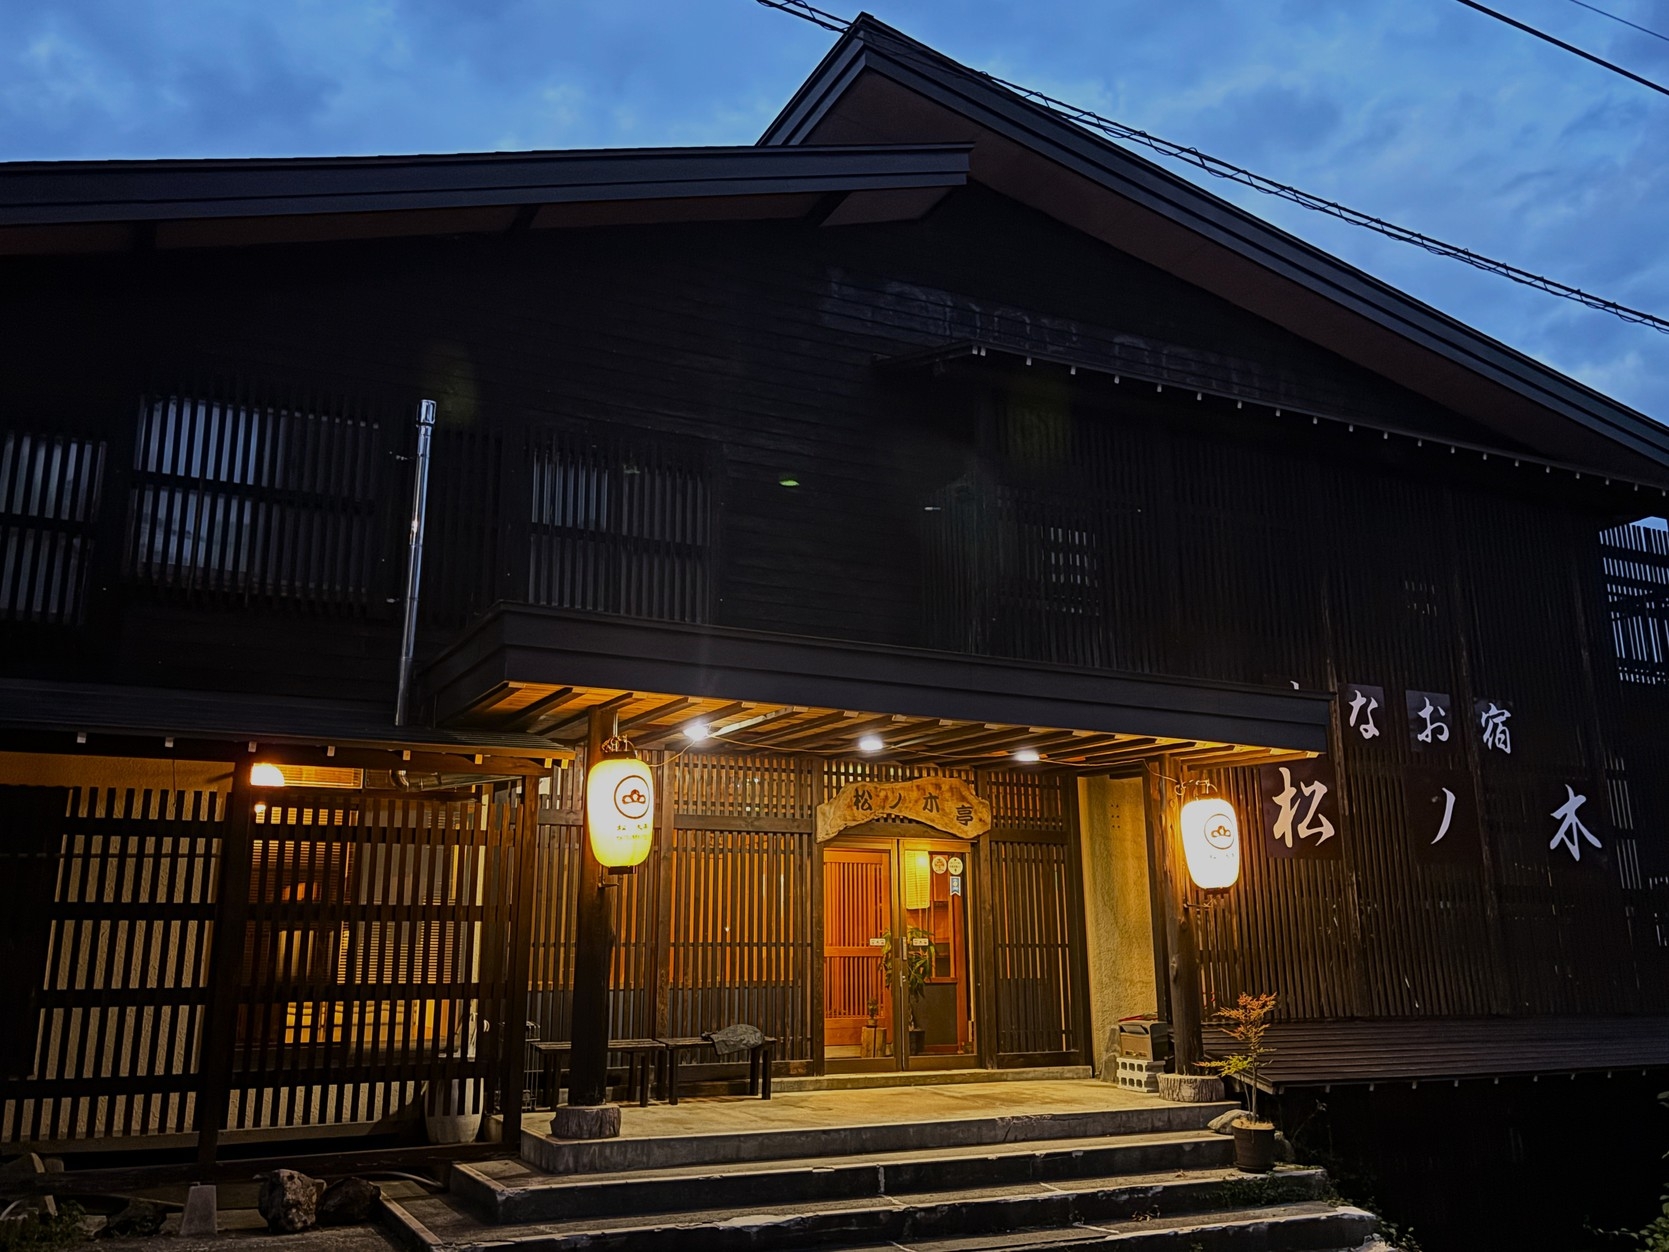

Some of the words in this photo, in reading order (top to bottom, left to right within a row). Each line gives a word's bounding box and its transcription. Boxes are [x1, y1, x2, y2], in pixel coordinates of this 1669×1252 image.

[1290, 680, 1512, 755] なお宿
[852, 788, 974, 826] 松ノ木亭
[1272, 766, 1603, 862] 松ノ木
